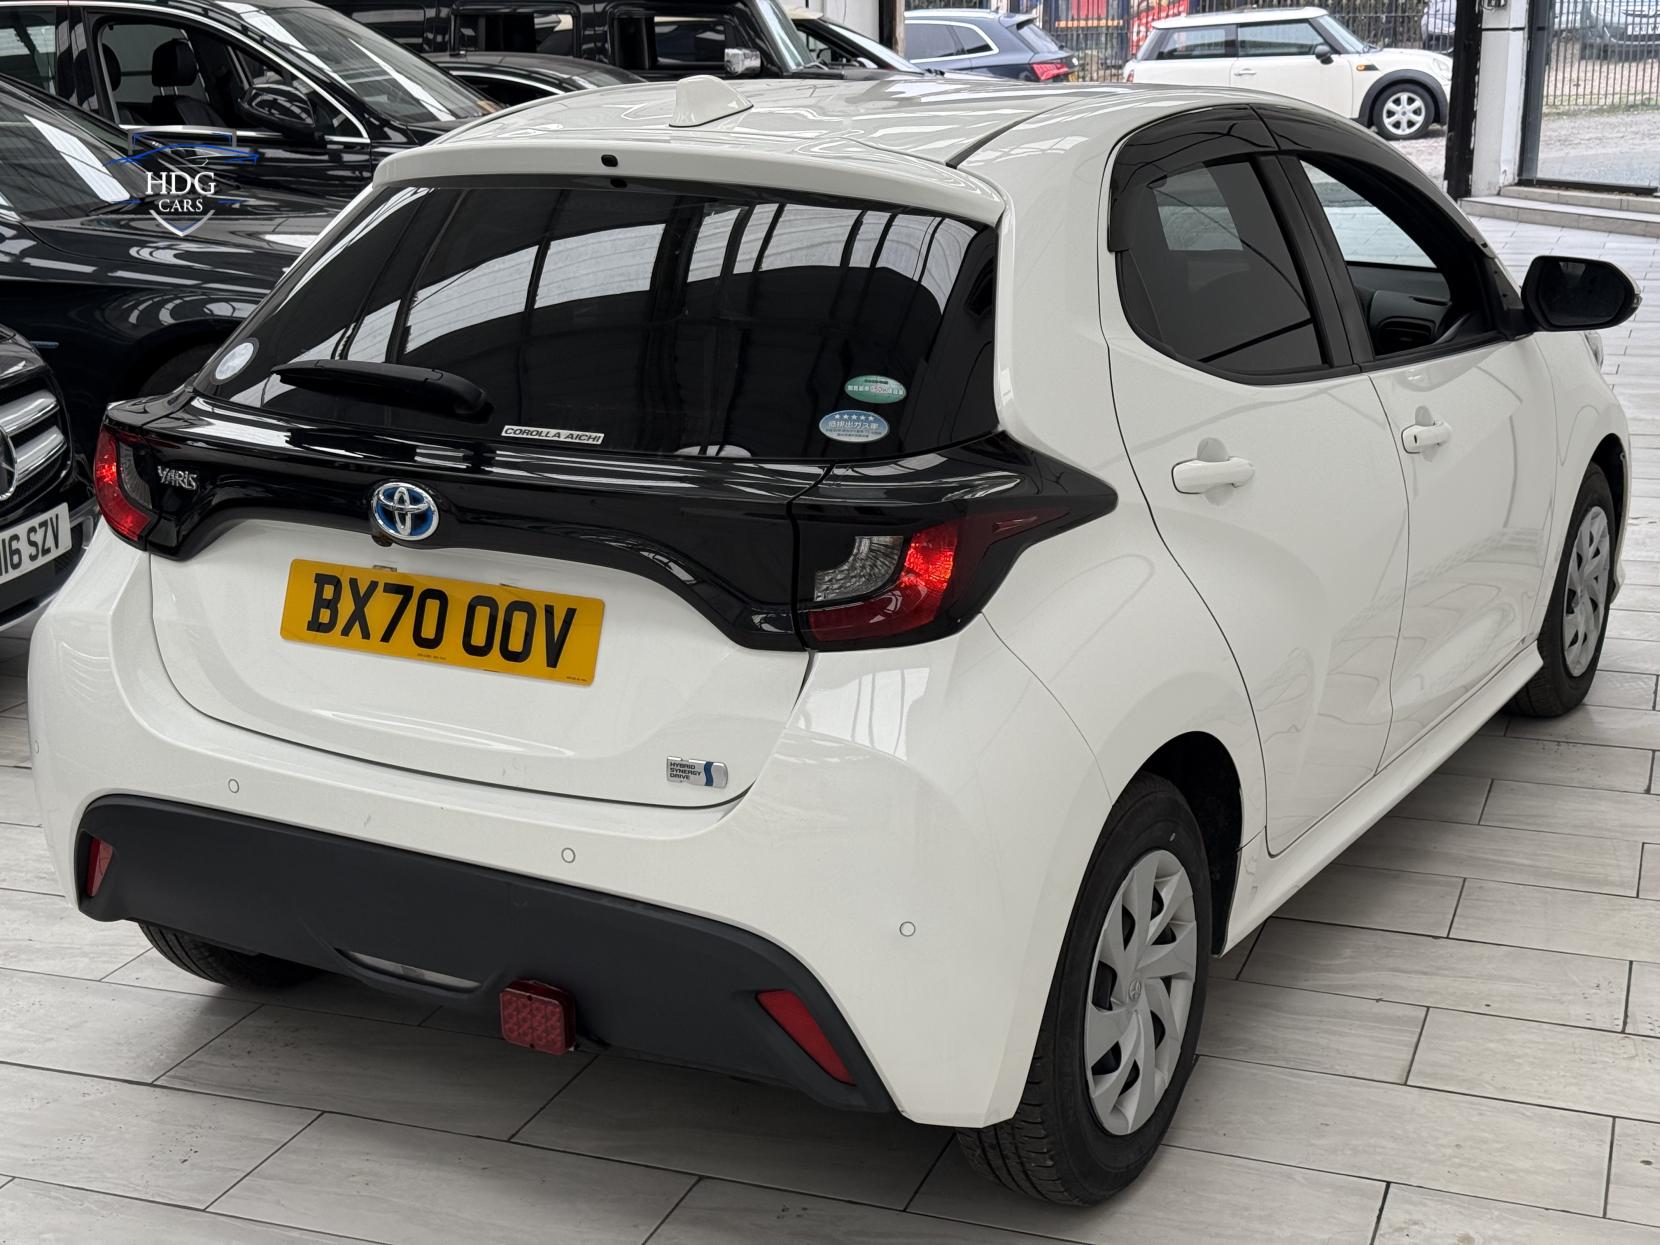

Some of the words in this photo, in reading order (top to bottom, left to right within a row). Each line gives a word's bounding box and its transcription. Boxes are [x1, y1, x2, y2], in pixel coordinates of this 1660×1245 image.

[504, 427, 562, 439] COROLLA
[564, 432, 602, 443] AICHI
[157, 465, 197, 490] YARIS
[0, 533, 23, 575] 16
[26, 513, 59, 562] SZV
[306, 573, 448, 650] BX70
[461, 595, 577, 668] OOV
[669, 761, 696, 770] HYBRID
[669, 767, 702, 776] SYNERGY
